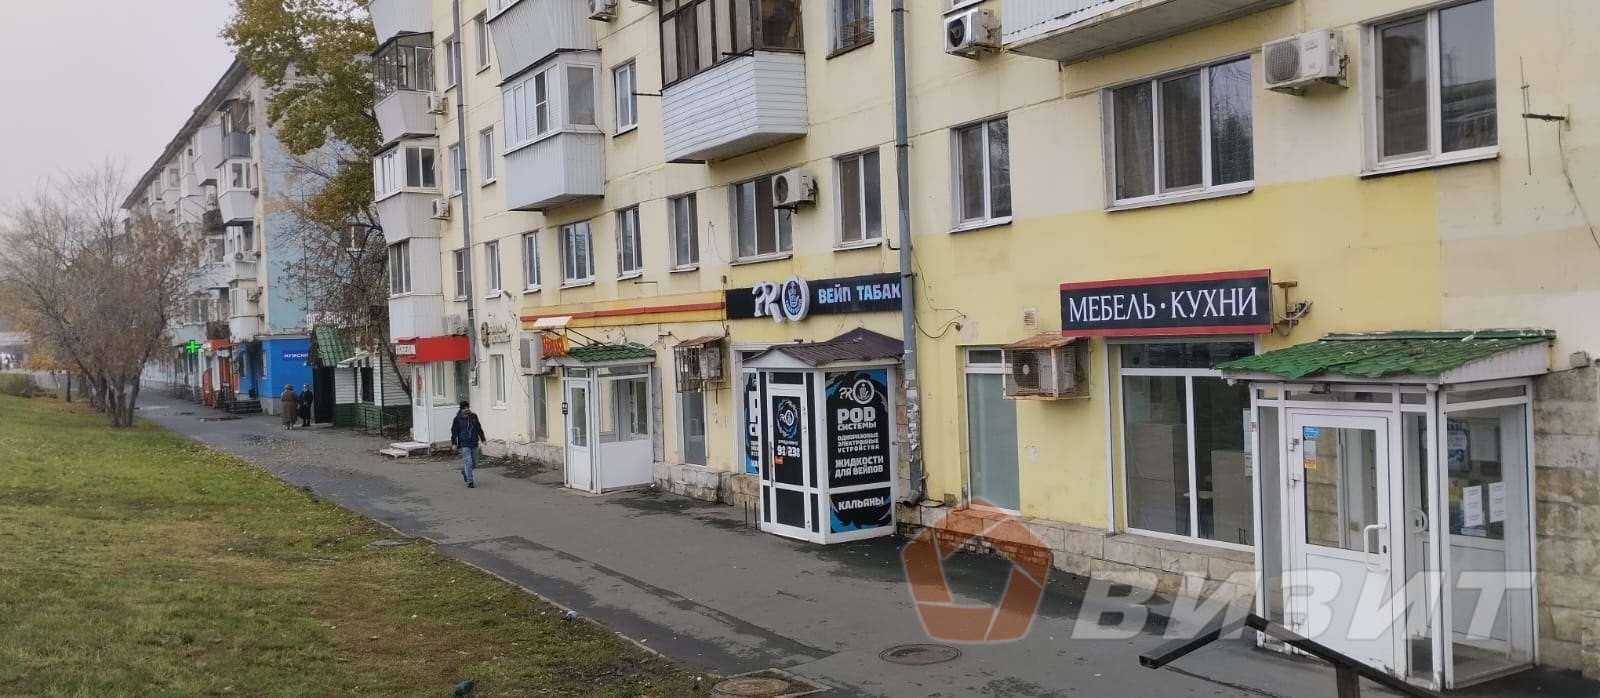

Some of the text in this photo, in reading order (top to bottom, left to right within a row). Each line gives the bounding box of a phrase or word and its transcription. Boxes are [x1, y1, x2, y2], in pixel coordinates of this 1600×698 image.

[752, 275, 810, 324] PRO
[818, 282, 902, 304] ВЕЙП ТАБАК
[1069, 286, 1258, 322] МЕБЕЛЬ КУХНИ
[837, 407, 876, 424] POD
[837, 421, 877, 431] СИСТЕМЫ
[837, 444, 880, 453] УСТРОЙСТВА
[835, 455, 884, 468] ЖИДКОСТИ
[834, 464, 884, 479] ДЛЯ ВЕЙПОВ
[838, 496, 884, 511] КАЛЬЯНЫ
